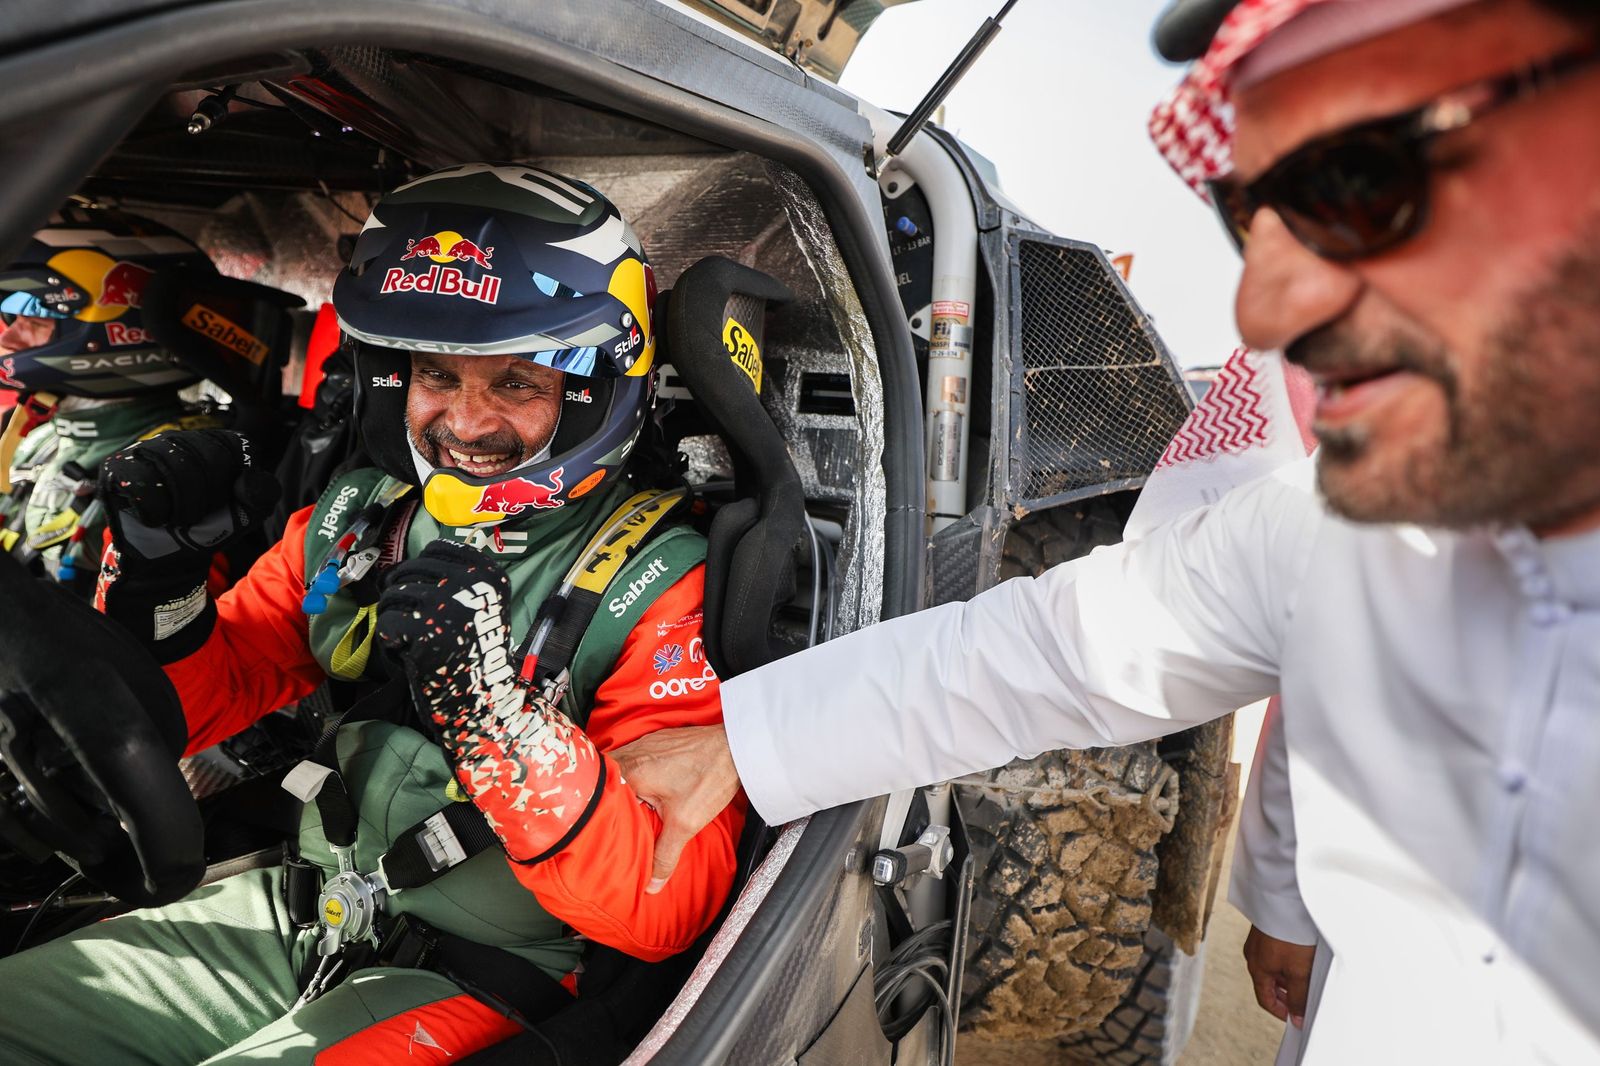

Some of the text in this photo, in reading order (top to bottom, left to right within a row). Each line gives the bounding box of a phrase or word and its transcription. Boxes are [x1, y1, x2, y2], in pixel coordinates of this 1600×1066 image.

[918, 235, 931, 248] BAR
[380, 266, 501, 305] Red Bull
[615, 325, 641, 359] Stilo
[372, 371, 403, 389] Stilo
[565, 387, 593, 404] Stilo
[317, 484, 359, 543] Sabelt
[608, 556, 669, 618] Sabelt
